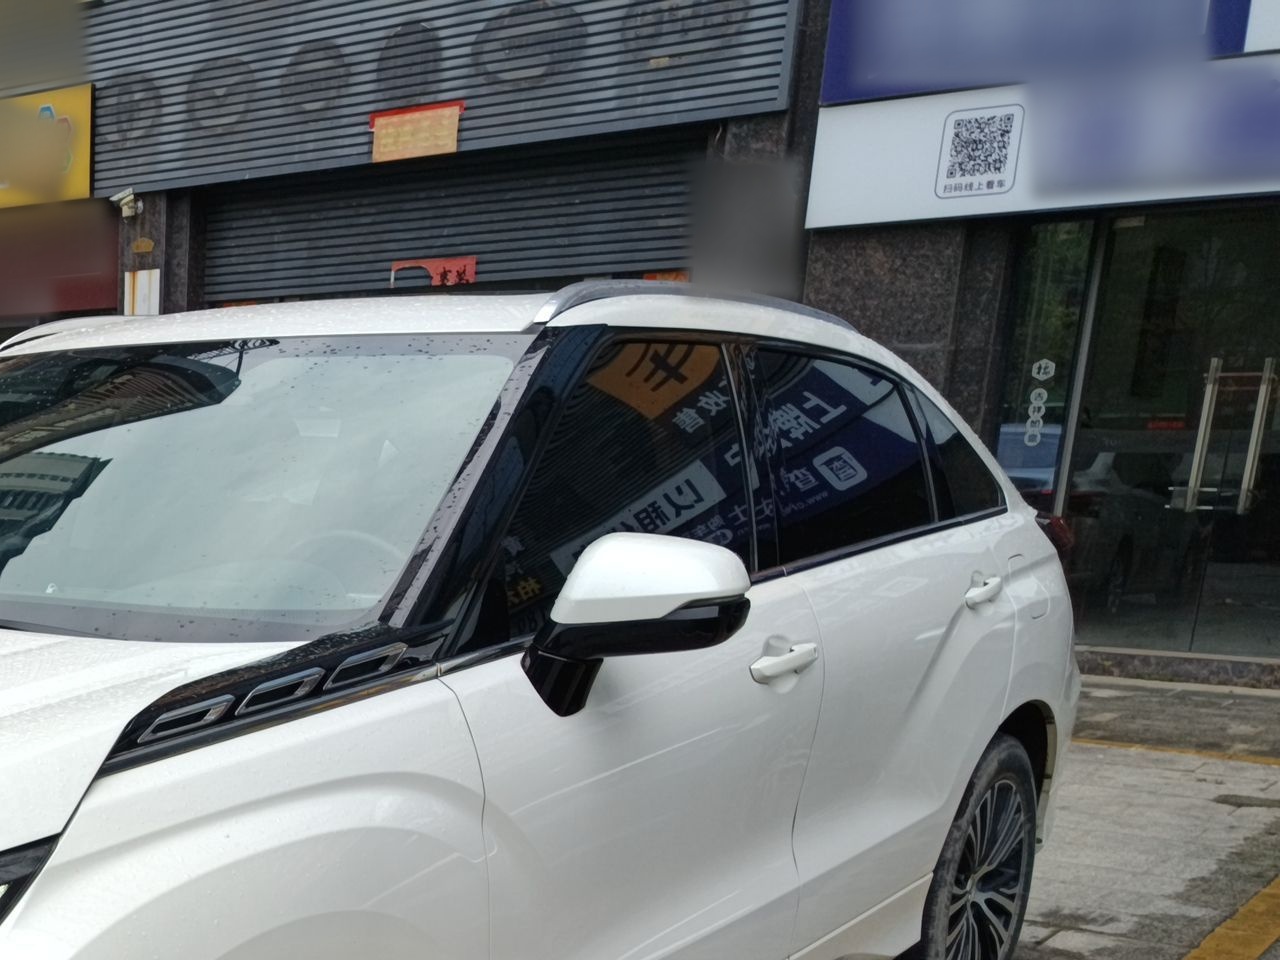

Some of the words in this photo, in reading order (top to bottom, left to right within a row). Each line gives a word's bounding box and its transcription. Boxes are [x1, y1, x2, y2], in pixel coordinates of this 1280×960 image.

[943, 180, 1006, 193] 扫码线上看车
